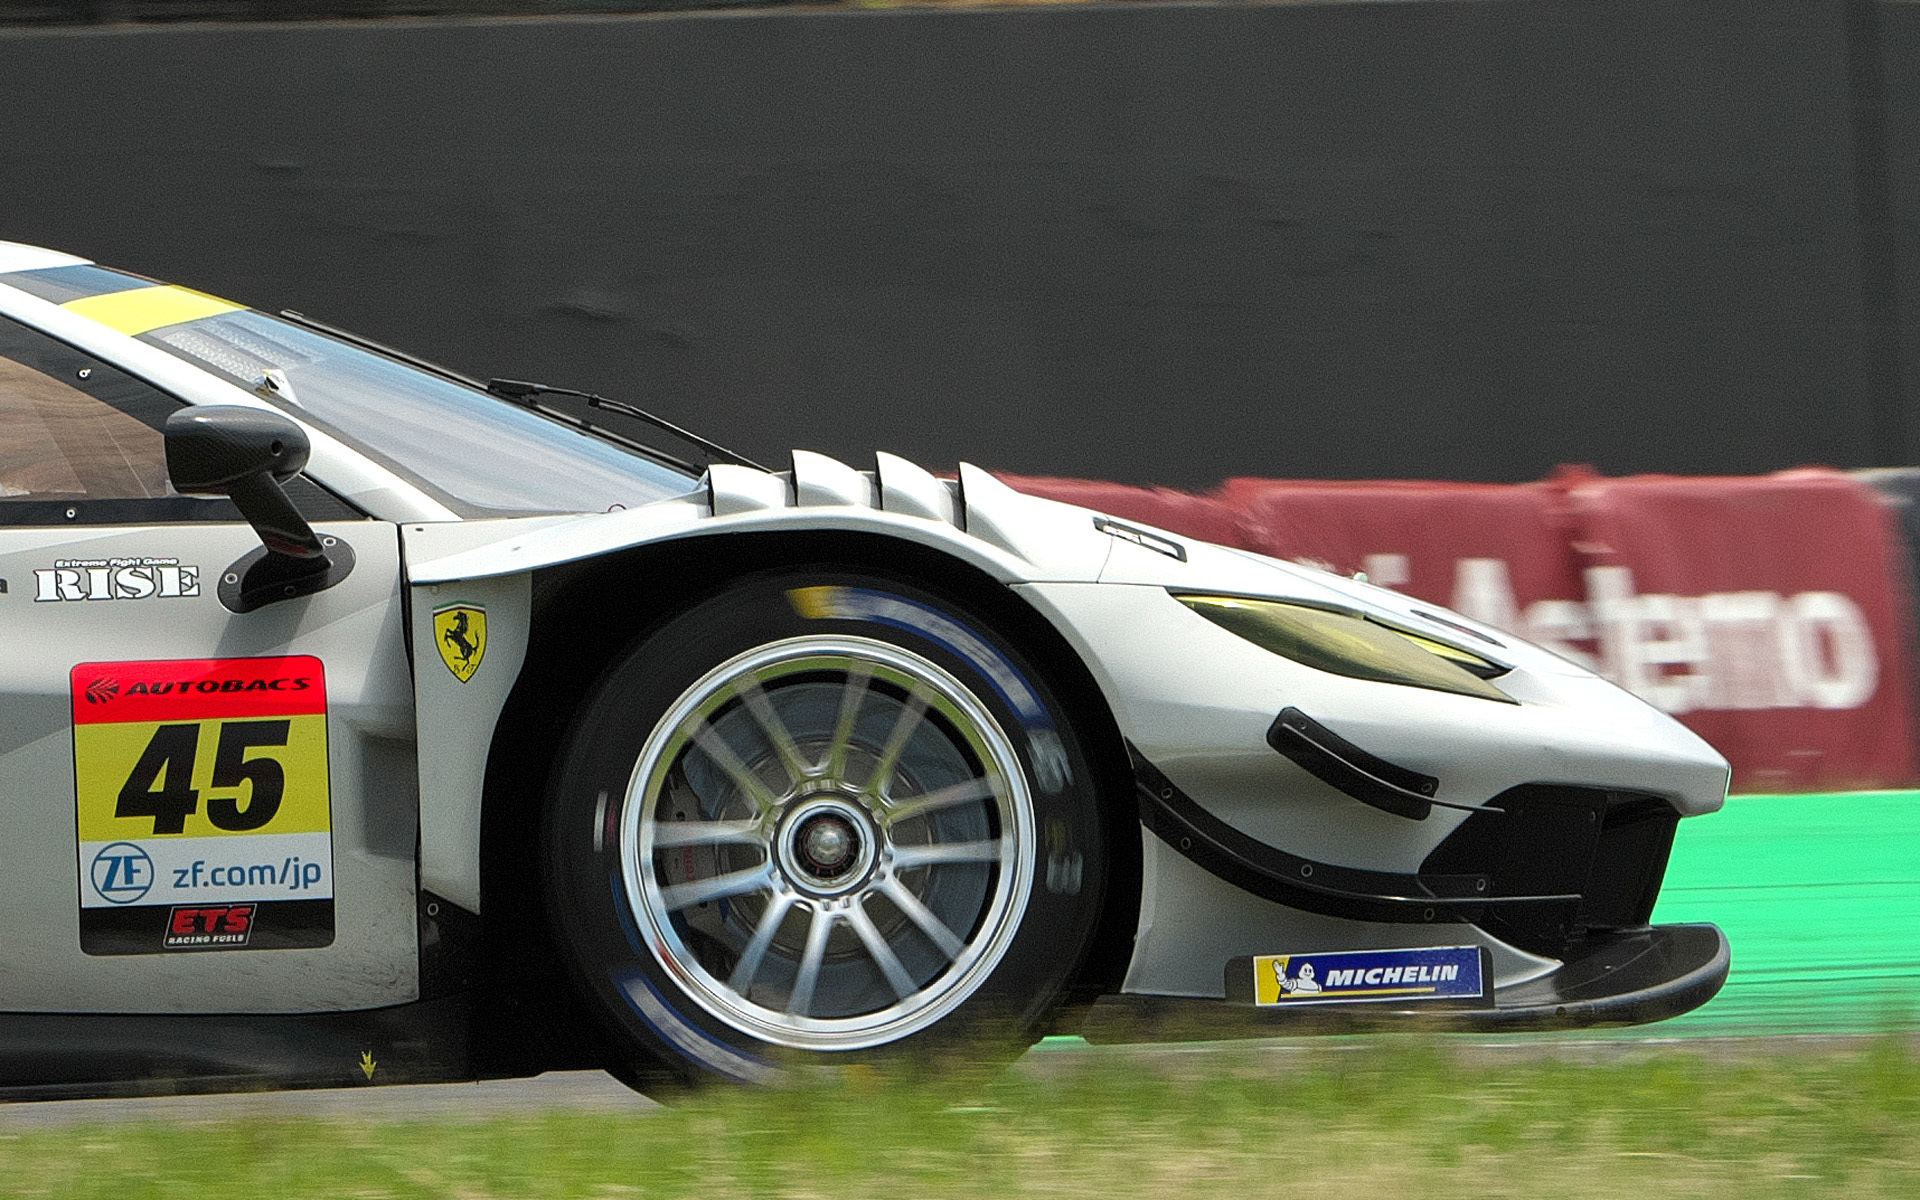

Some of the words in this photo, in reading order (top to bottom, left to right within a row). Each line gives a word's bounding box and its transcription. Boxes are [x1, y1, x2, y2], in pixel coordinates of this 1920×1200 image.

[54, 559, 107, 568] Extreme
[109, 558, 140, 567] Fight
[142, 558, 178, 567] Game
[34, 566, 199, 602] RISE
[125, 677, 311, 697] AUTOBACS
[114, 720, 291, 835] 45
[97, 855, 149, 892] ZF
[173, 857, 322, 890] zf.com/jp
[172, 908, 251, 934] ETS
[168, 936, 210, 945] RACING
[1325, 964, 1459, 987] MICHELIN
